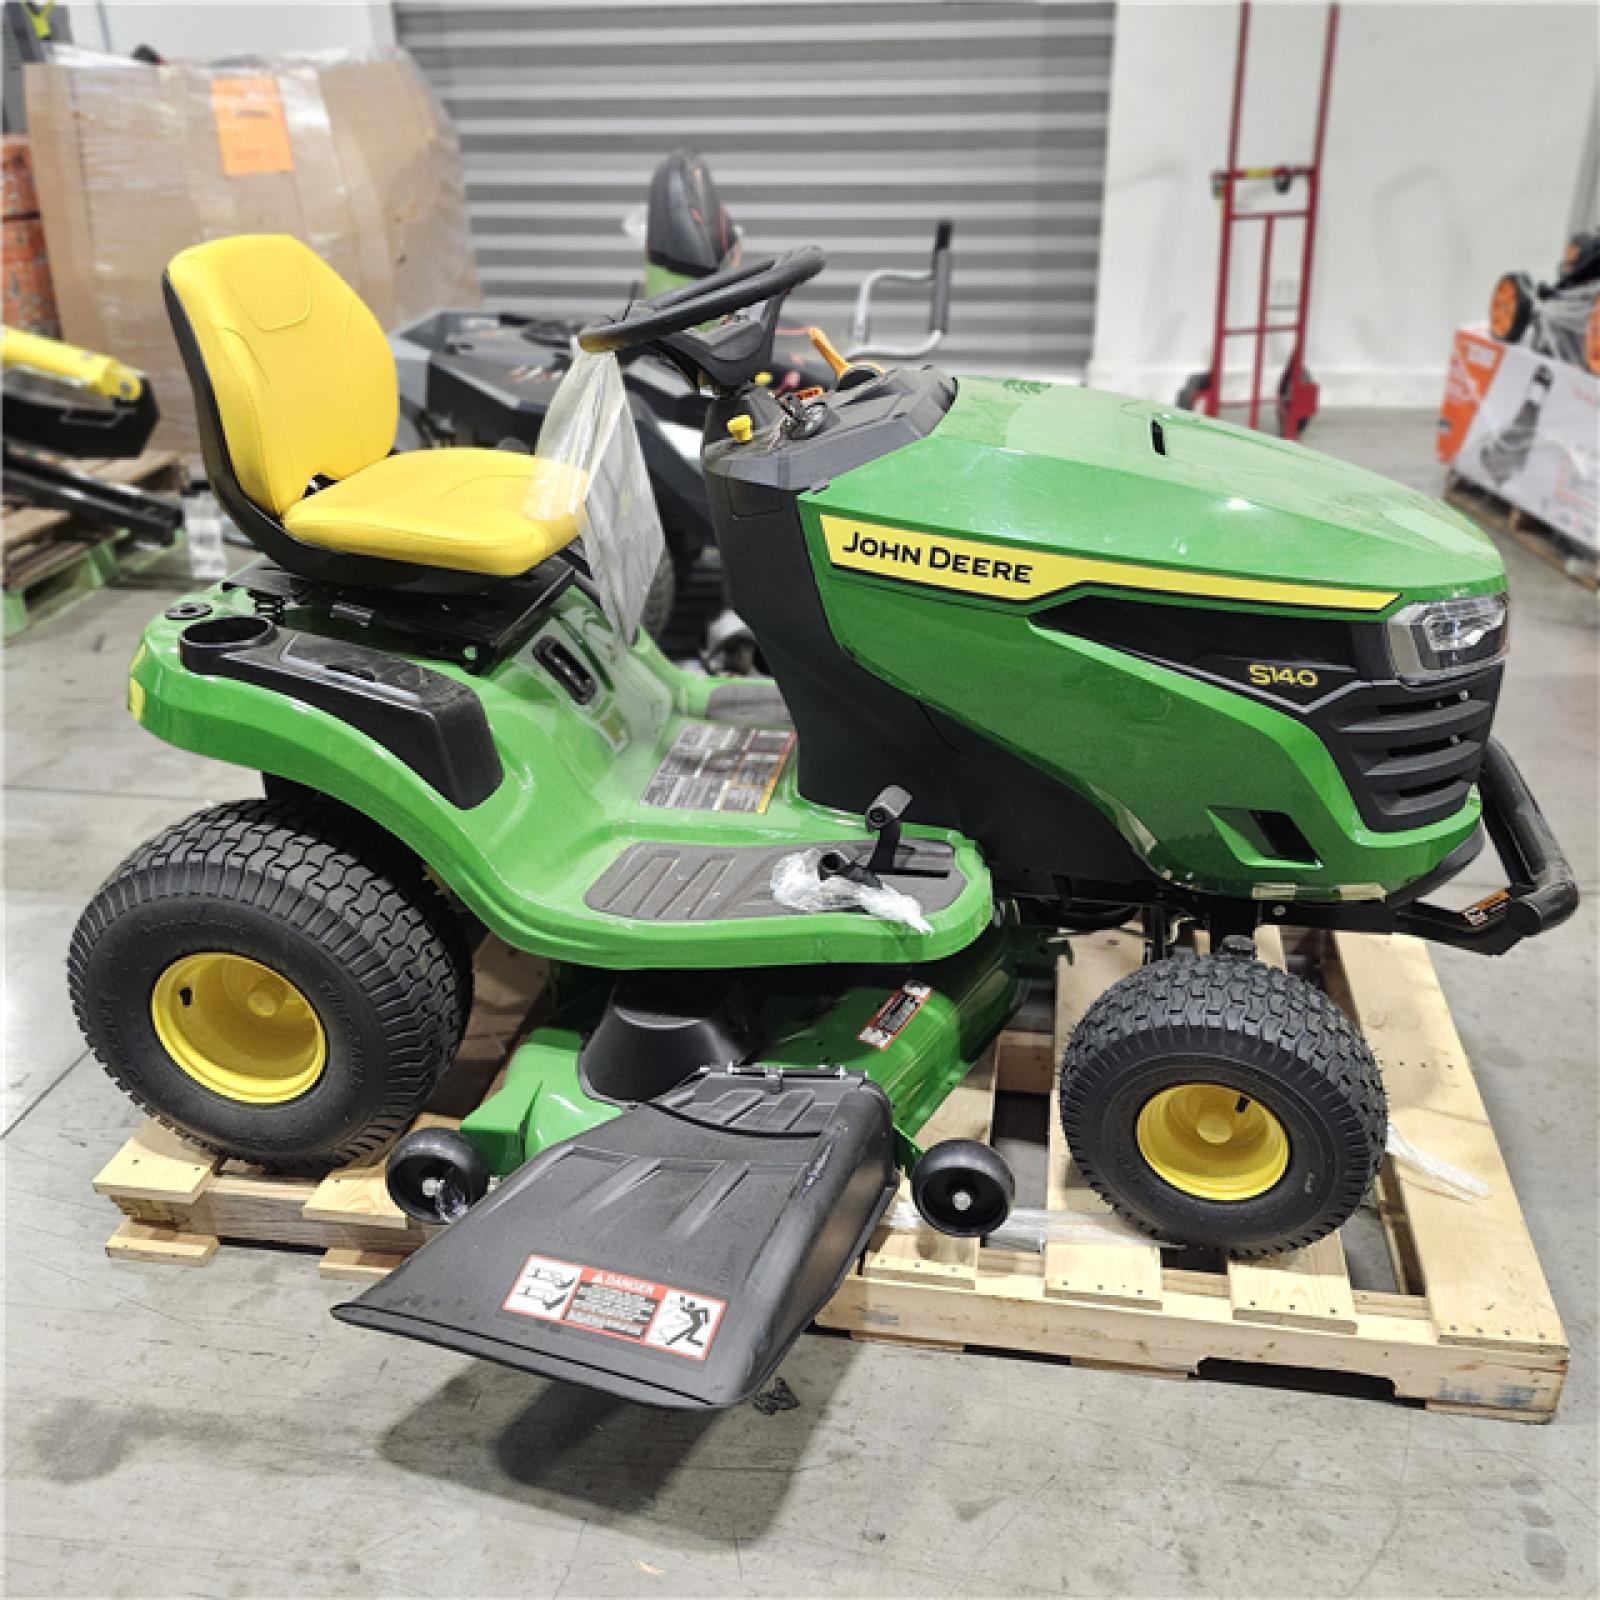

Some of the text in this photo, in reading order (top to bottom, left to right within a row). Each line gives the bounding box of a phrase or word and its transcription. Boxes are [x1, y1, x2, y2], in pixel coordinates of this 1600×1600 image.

[842, 531, 1034, 584] JOHN DEERE
[1247, 664, 1319, 687] S140
